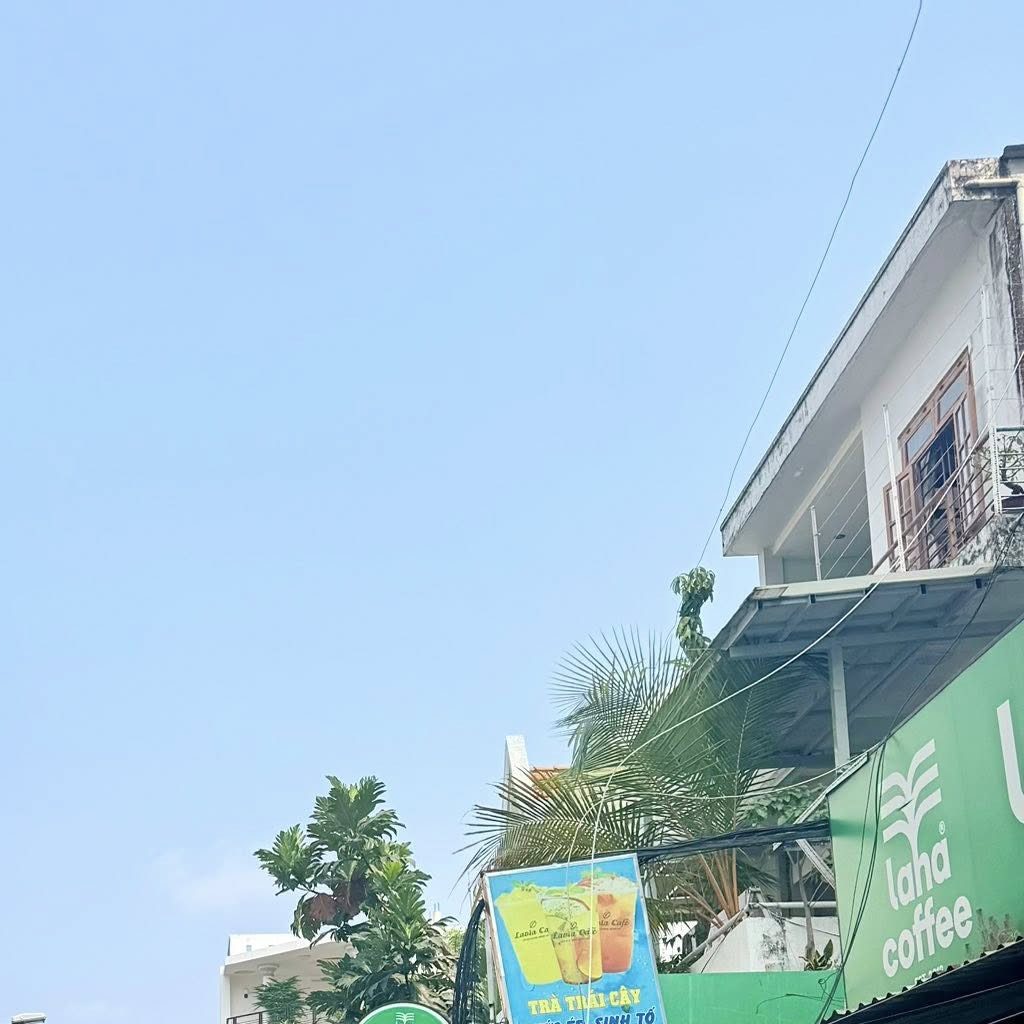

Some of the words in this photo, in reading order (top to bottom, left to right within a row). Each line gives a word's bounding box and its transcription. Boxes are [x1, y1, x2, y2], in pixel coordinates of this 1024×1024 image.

[885, 838, 952, 910] laha
[883, 896, 973, 978] coffee
[528, 992, 562, 1015] TRÀ
[564, 988, 607, 1011] TRÁI
[609, 985, 641, 1007] CÂY
